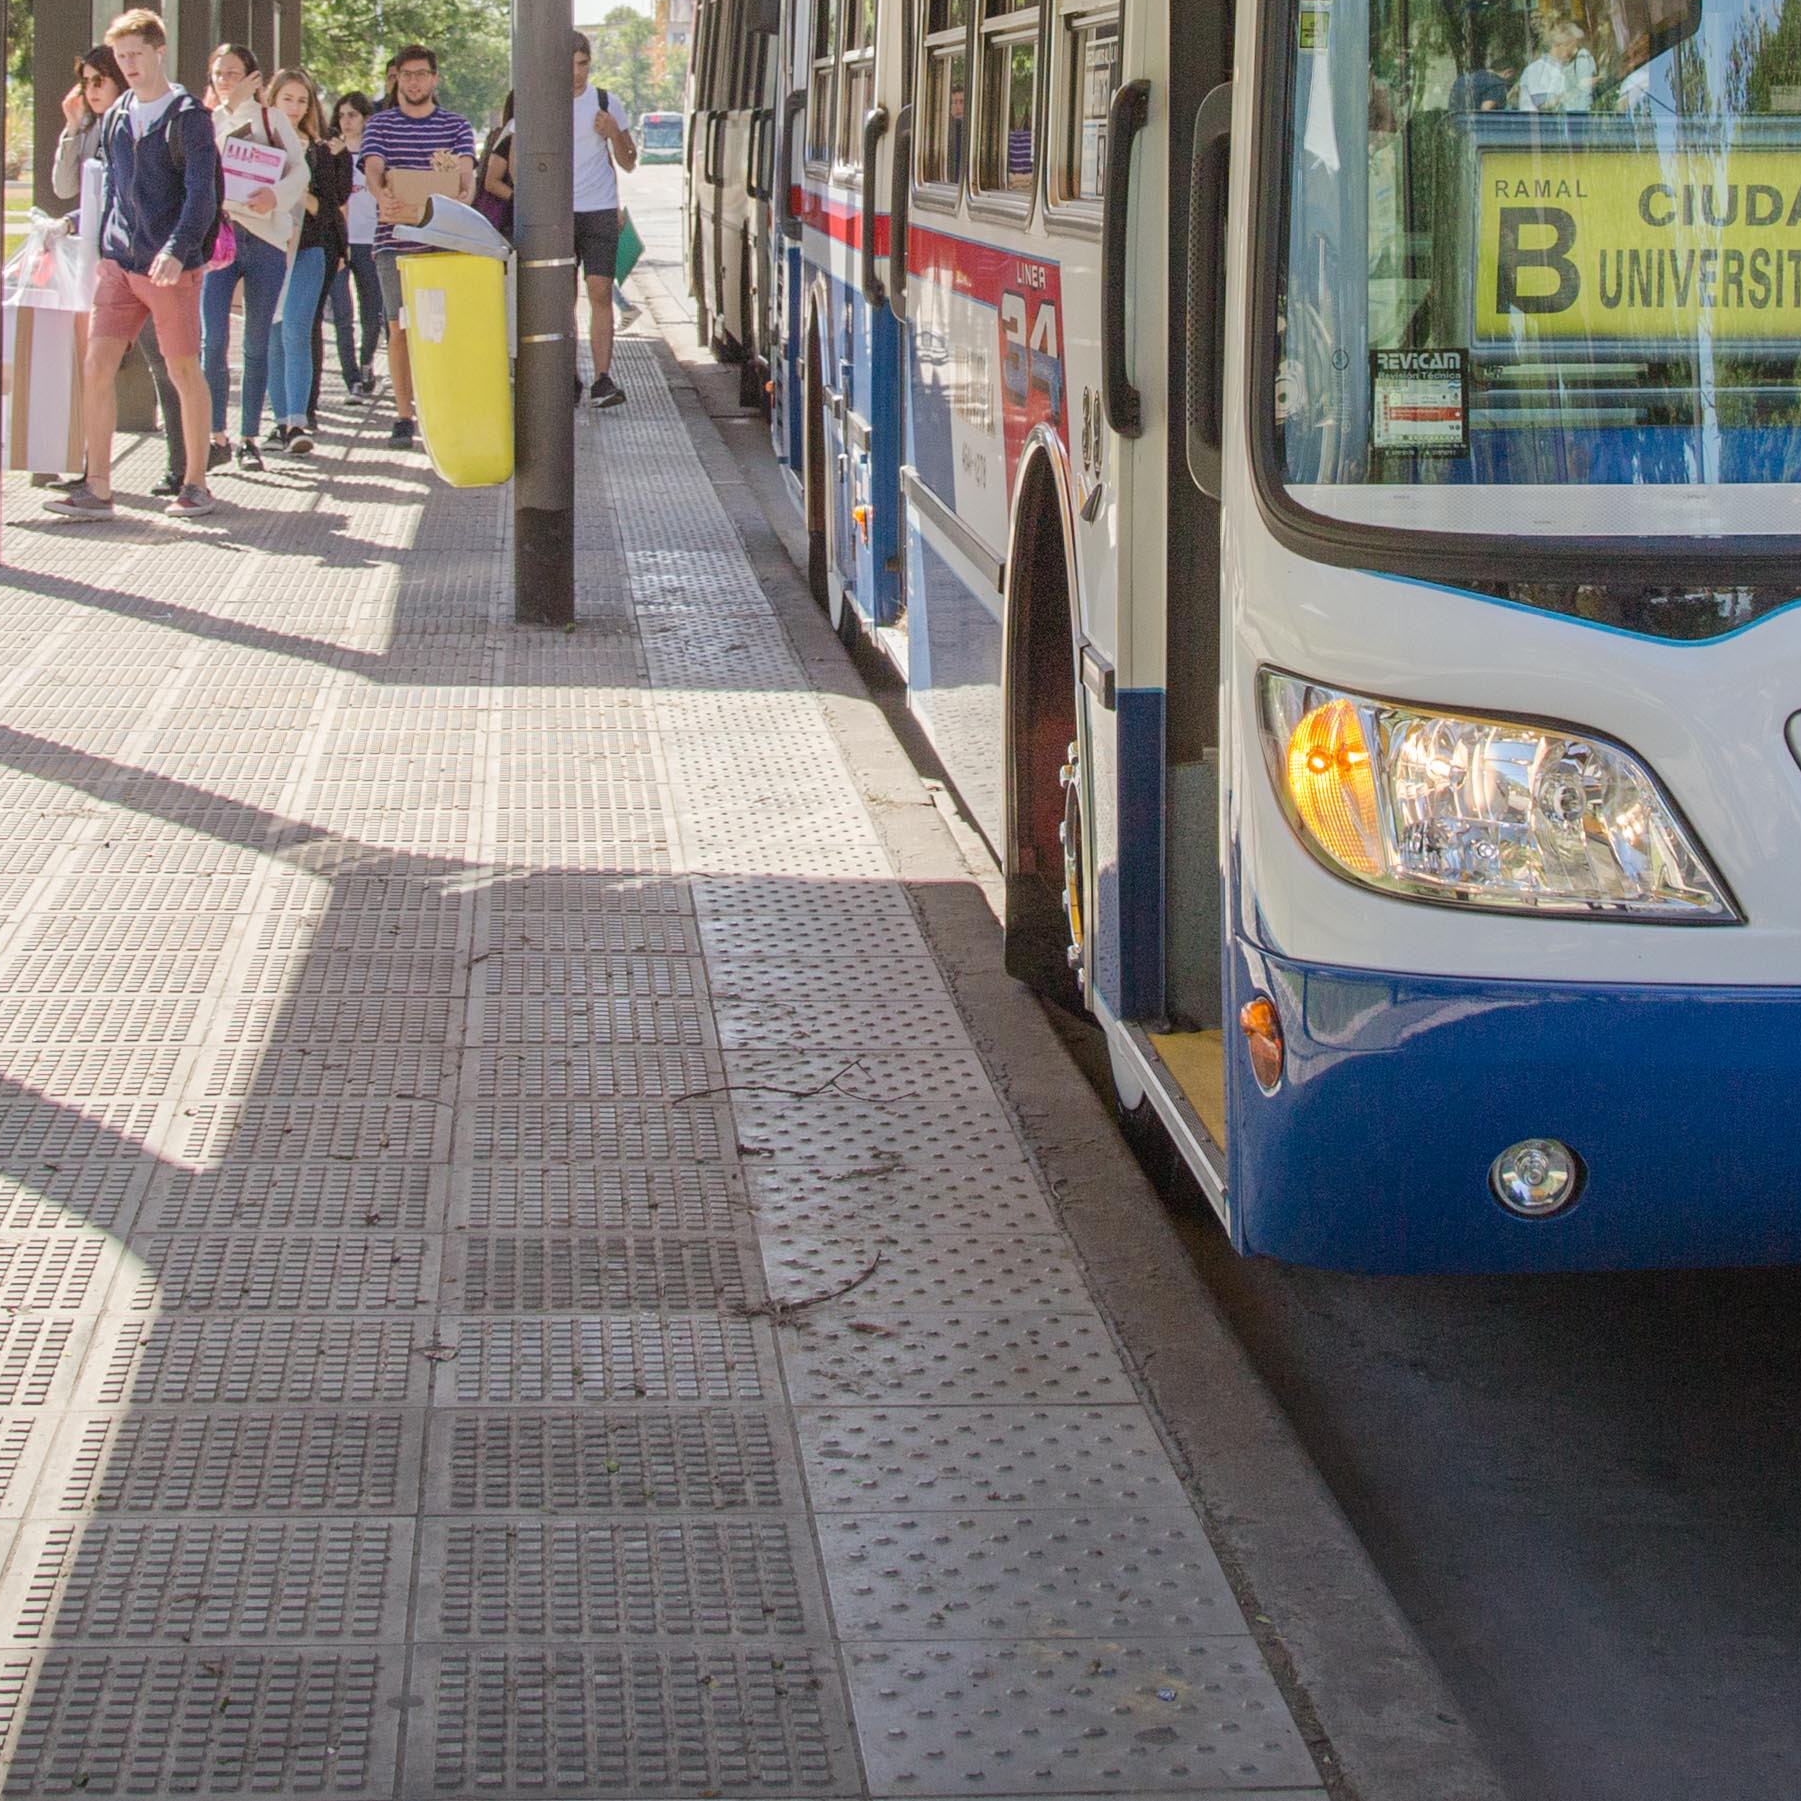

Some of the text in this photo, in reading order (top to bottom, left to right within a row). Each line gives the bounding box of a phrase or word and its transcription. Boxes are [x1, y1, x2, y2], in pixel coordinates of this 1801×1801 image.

[1494, 178, 1590, 199] RAMAL
[1016, 263, 1046, 290] LINEA
[1496, 206, 1582, 315] B
[1001, 292, 1063, 423] 34
